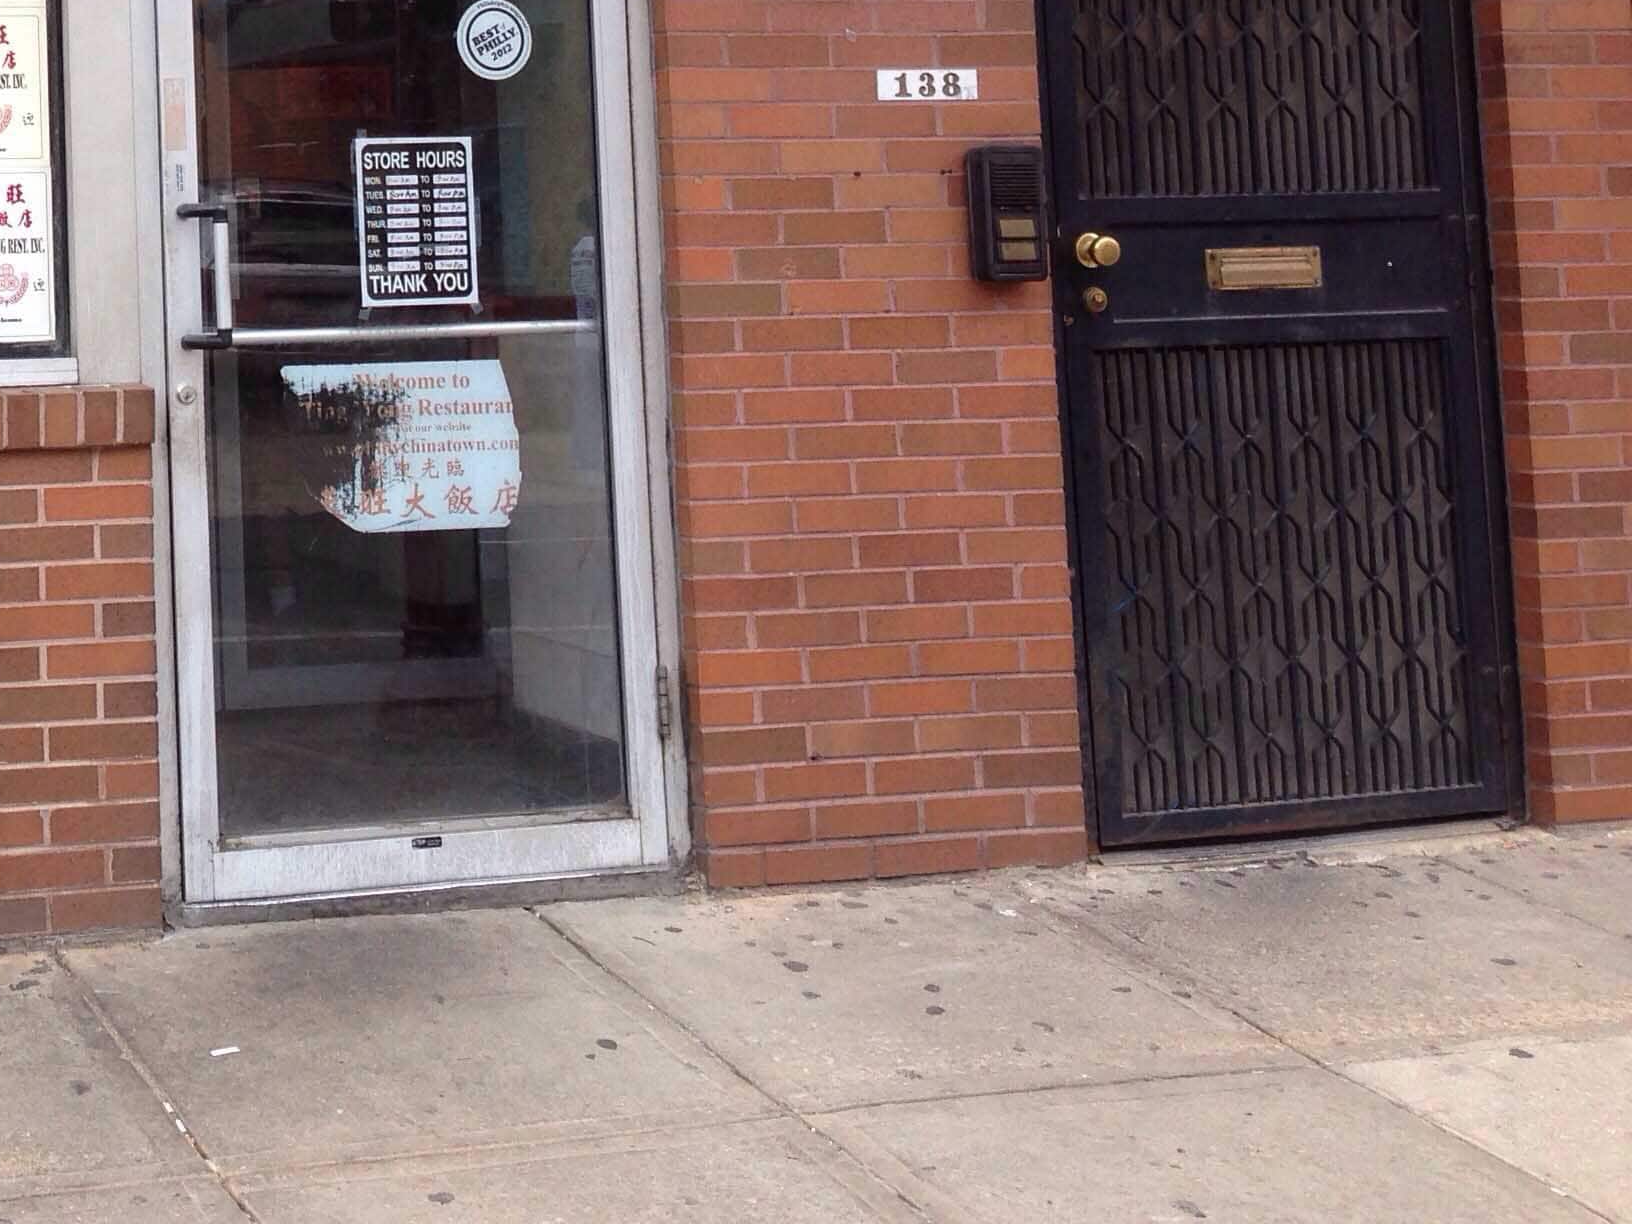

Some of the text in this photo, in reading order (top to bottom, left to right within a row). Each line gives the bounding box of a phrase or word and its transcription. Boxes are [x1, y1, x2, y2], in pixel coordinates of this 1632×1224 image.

[472, 24, 500, 46] BEST
[477, 27, 516, 56] PHILLY
[491, 44, 512, 61] 2012
[894, 72, 961, 97] 138
[364, 151, 465, 170] STORE HOURS
[420, 176, 430, 184] TO
[422, 204, 431, 212] TO
[423, 219, 432, 227] TO
[423, 233, 432, 242] TO
[424, 248, 433, 256] TO
[424, 262, 433, 270] TO
[369, 272, 468, 294] THANK YOU
[452, 374, 470, 389] to
[416, 425, 431, 433] our
[435, 423, 471, 432] website
